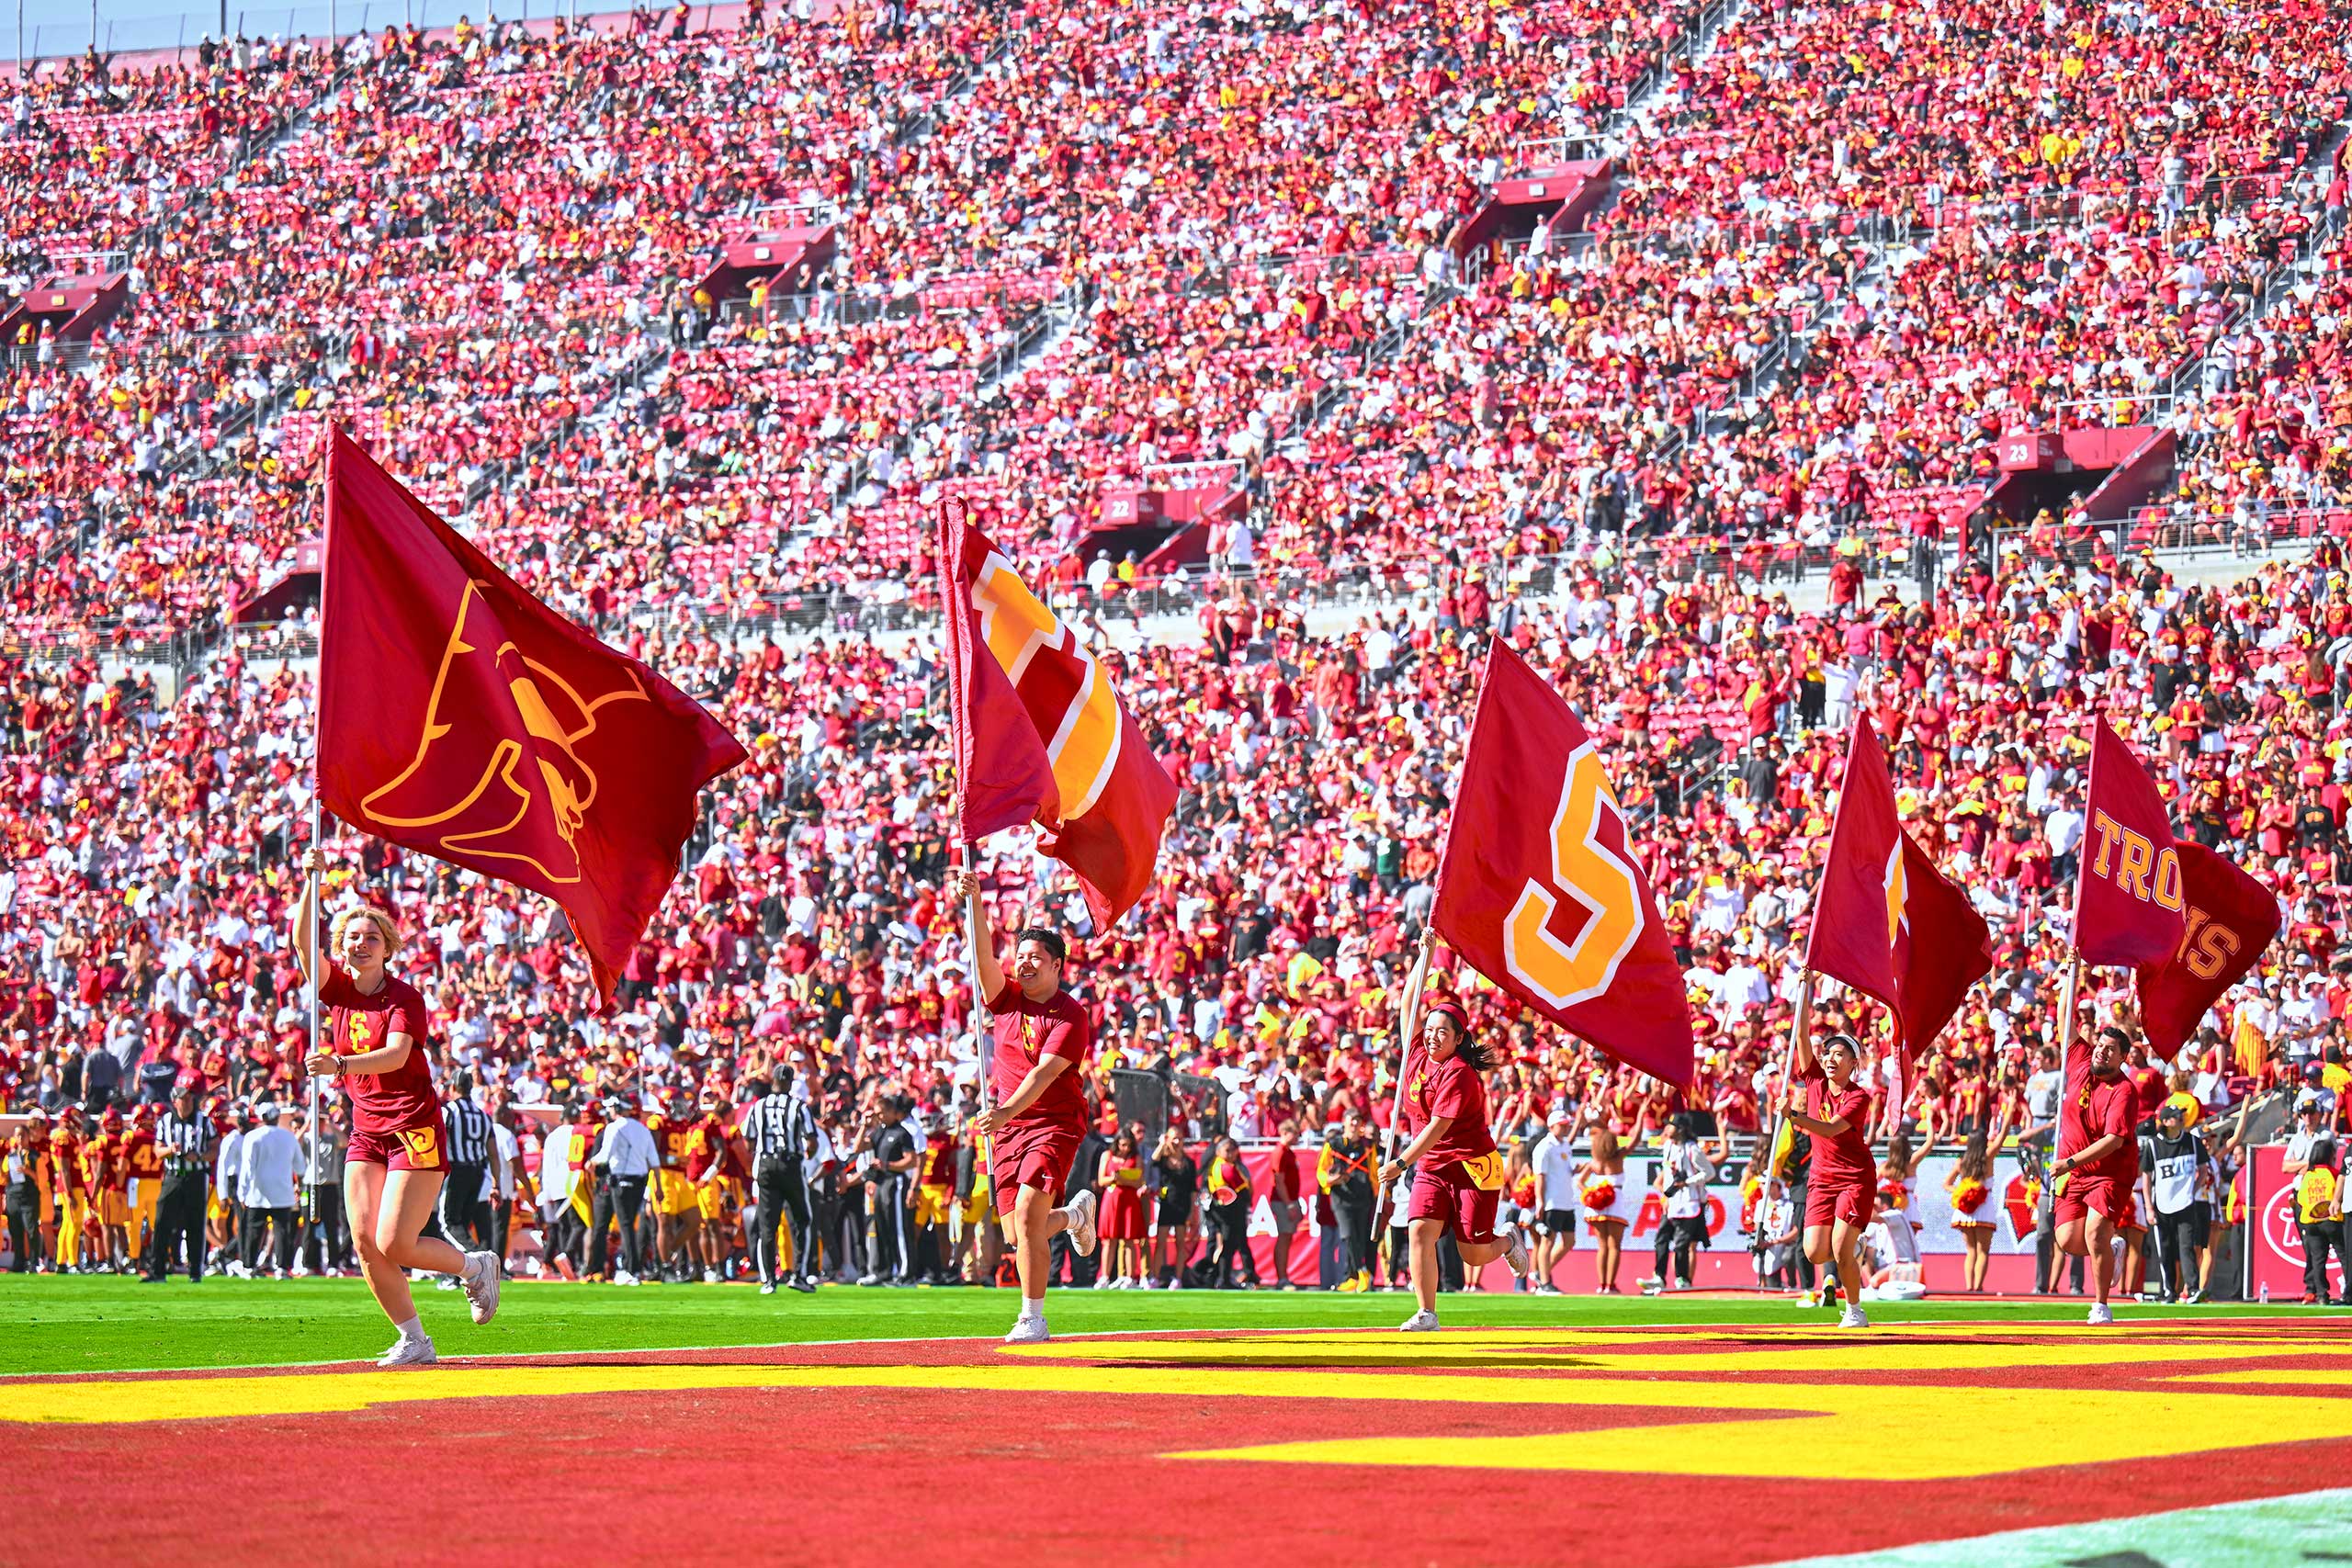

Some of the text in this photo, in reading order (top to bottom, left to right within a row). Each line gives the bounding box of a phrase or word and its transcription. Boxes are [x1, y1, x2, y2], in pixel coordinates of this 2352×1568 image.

[2008, 445, 2029, 462] 23
[1111, 500, 1129, 517] 22
[1503, 739, 1646, 1010] S
[465, 1112, 481, 1139] U
